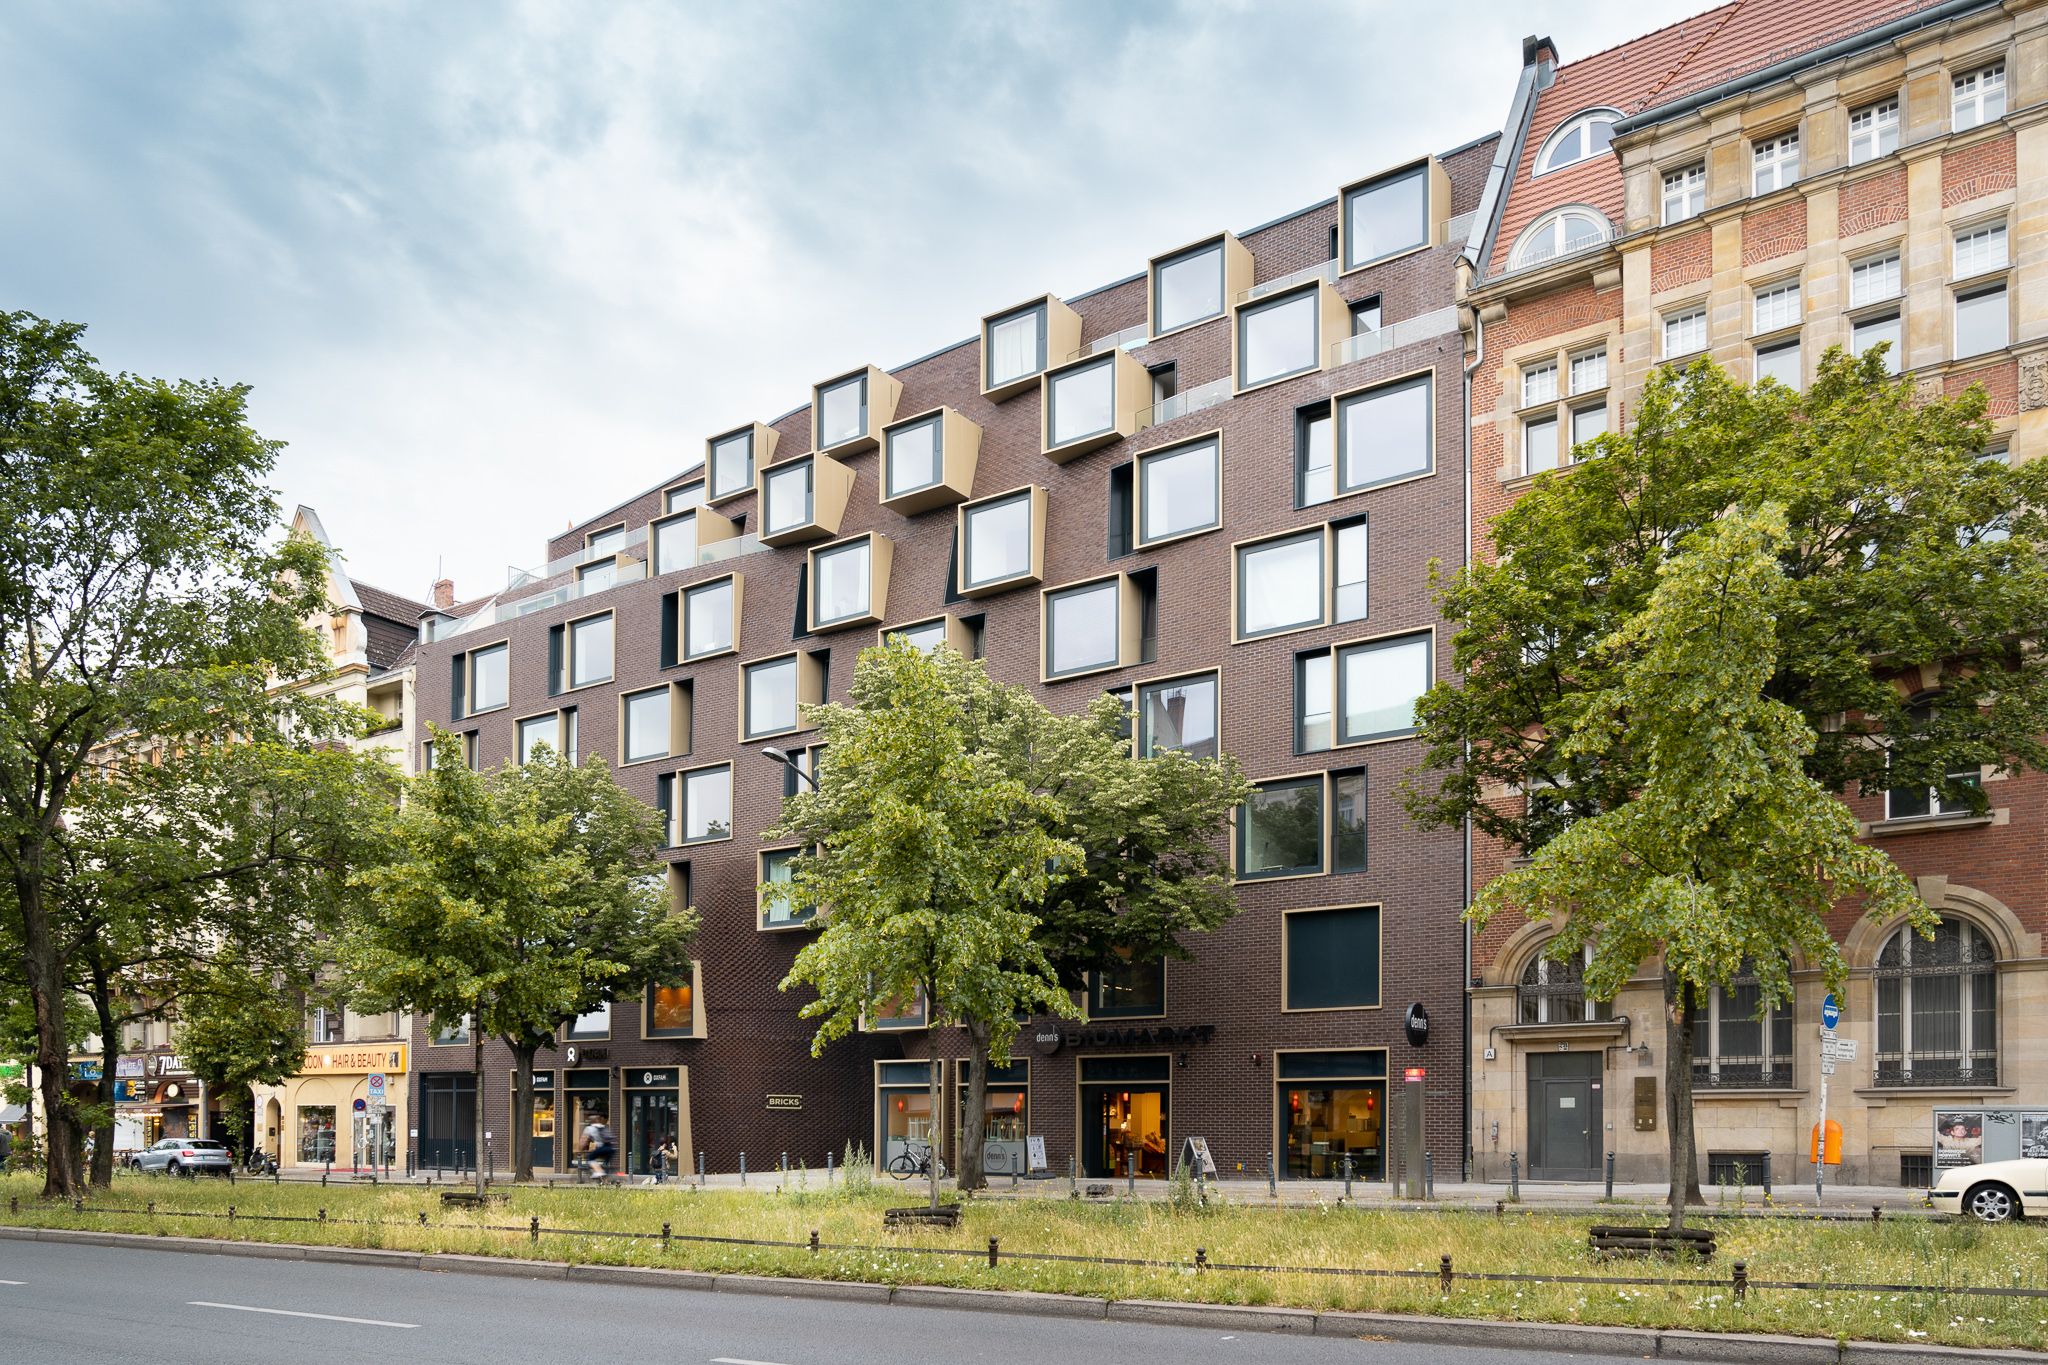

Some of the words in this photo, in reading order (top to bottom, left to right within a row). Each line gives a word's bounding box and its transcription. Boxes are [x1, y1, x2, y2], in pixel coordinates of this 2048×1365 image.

[1411, 1011, 1427, 1030] denn's
[1036, 1029, 1059, 1043] denn's
[1486, 1050, 1493, 1058] A
[333, 1054, 350, 1069] HAIR
[351, 1053, 356, 1068] &
[357, 1052, 387, 1068] BEAUTY
[769, 1098, 800, 1106] BRICKS
[986, 1151, 1006, 1161] denn's
